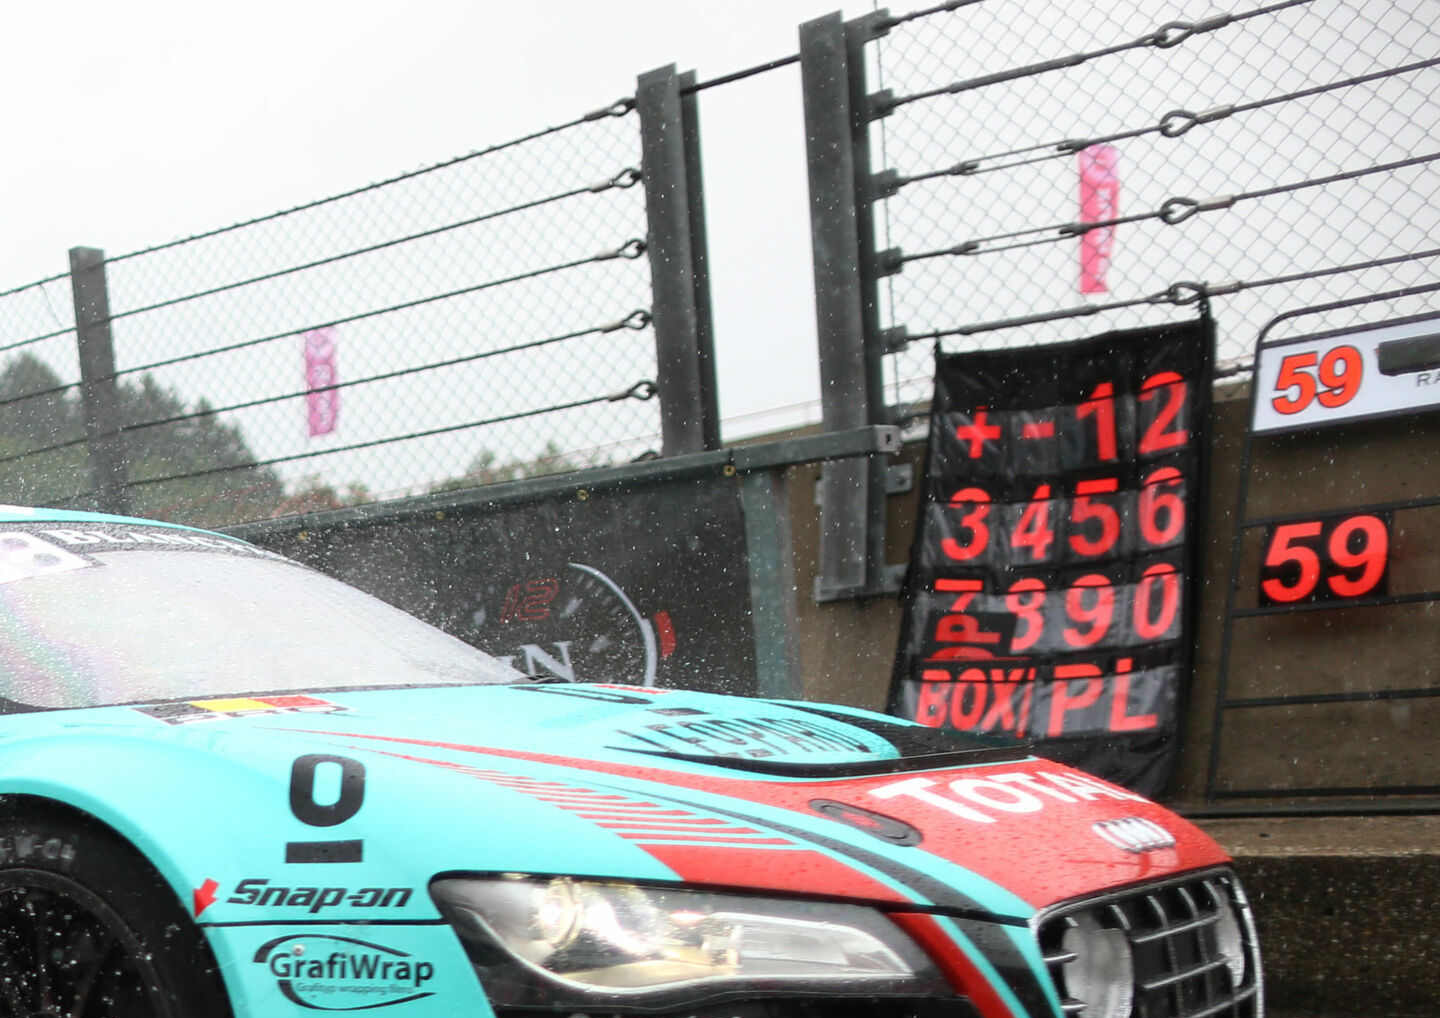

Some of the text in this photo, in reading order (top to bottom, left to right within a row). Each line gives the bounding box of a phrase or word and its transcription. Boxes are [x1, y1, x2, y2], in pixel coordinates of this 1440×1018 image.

[1271, 344, 1364, 416] 59
[1262, 515, 1389, 603] 59
[1046, 656, 1160, 738] PL
[226, 878, 413, 914] Snap-on
[270, 952, 435, 988] GrafiWrap
